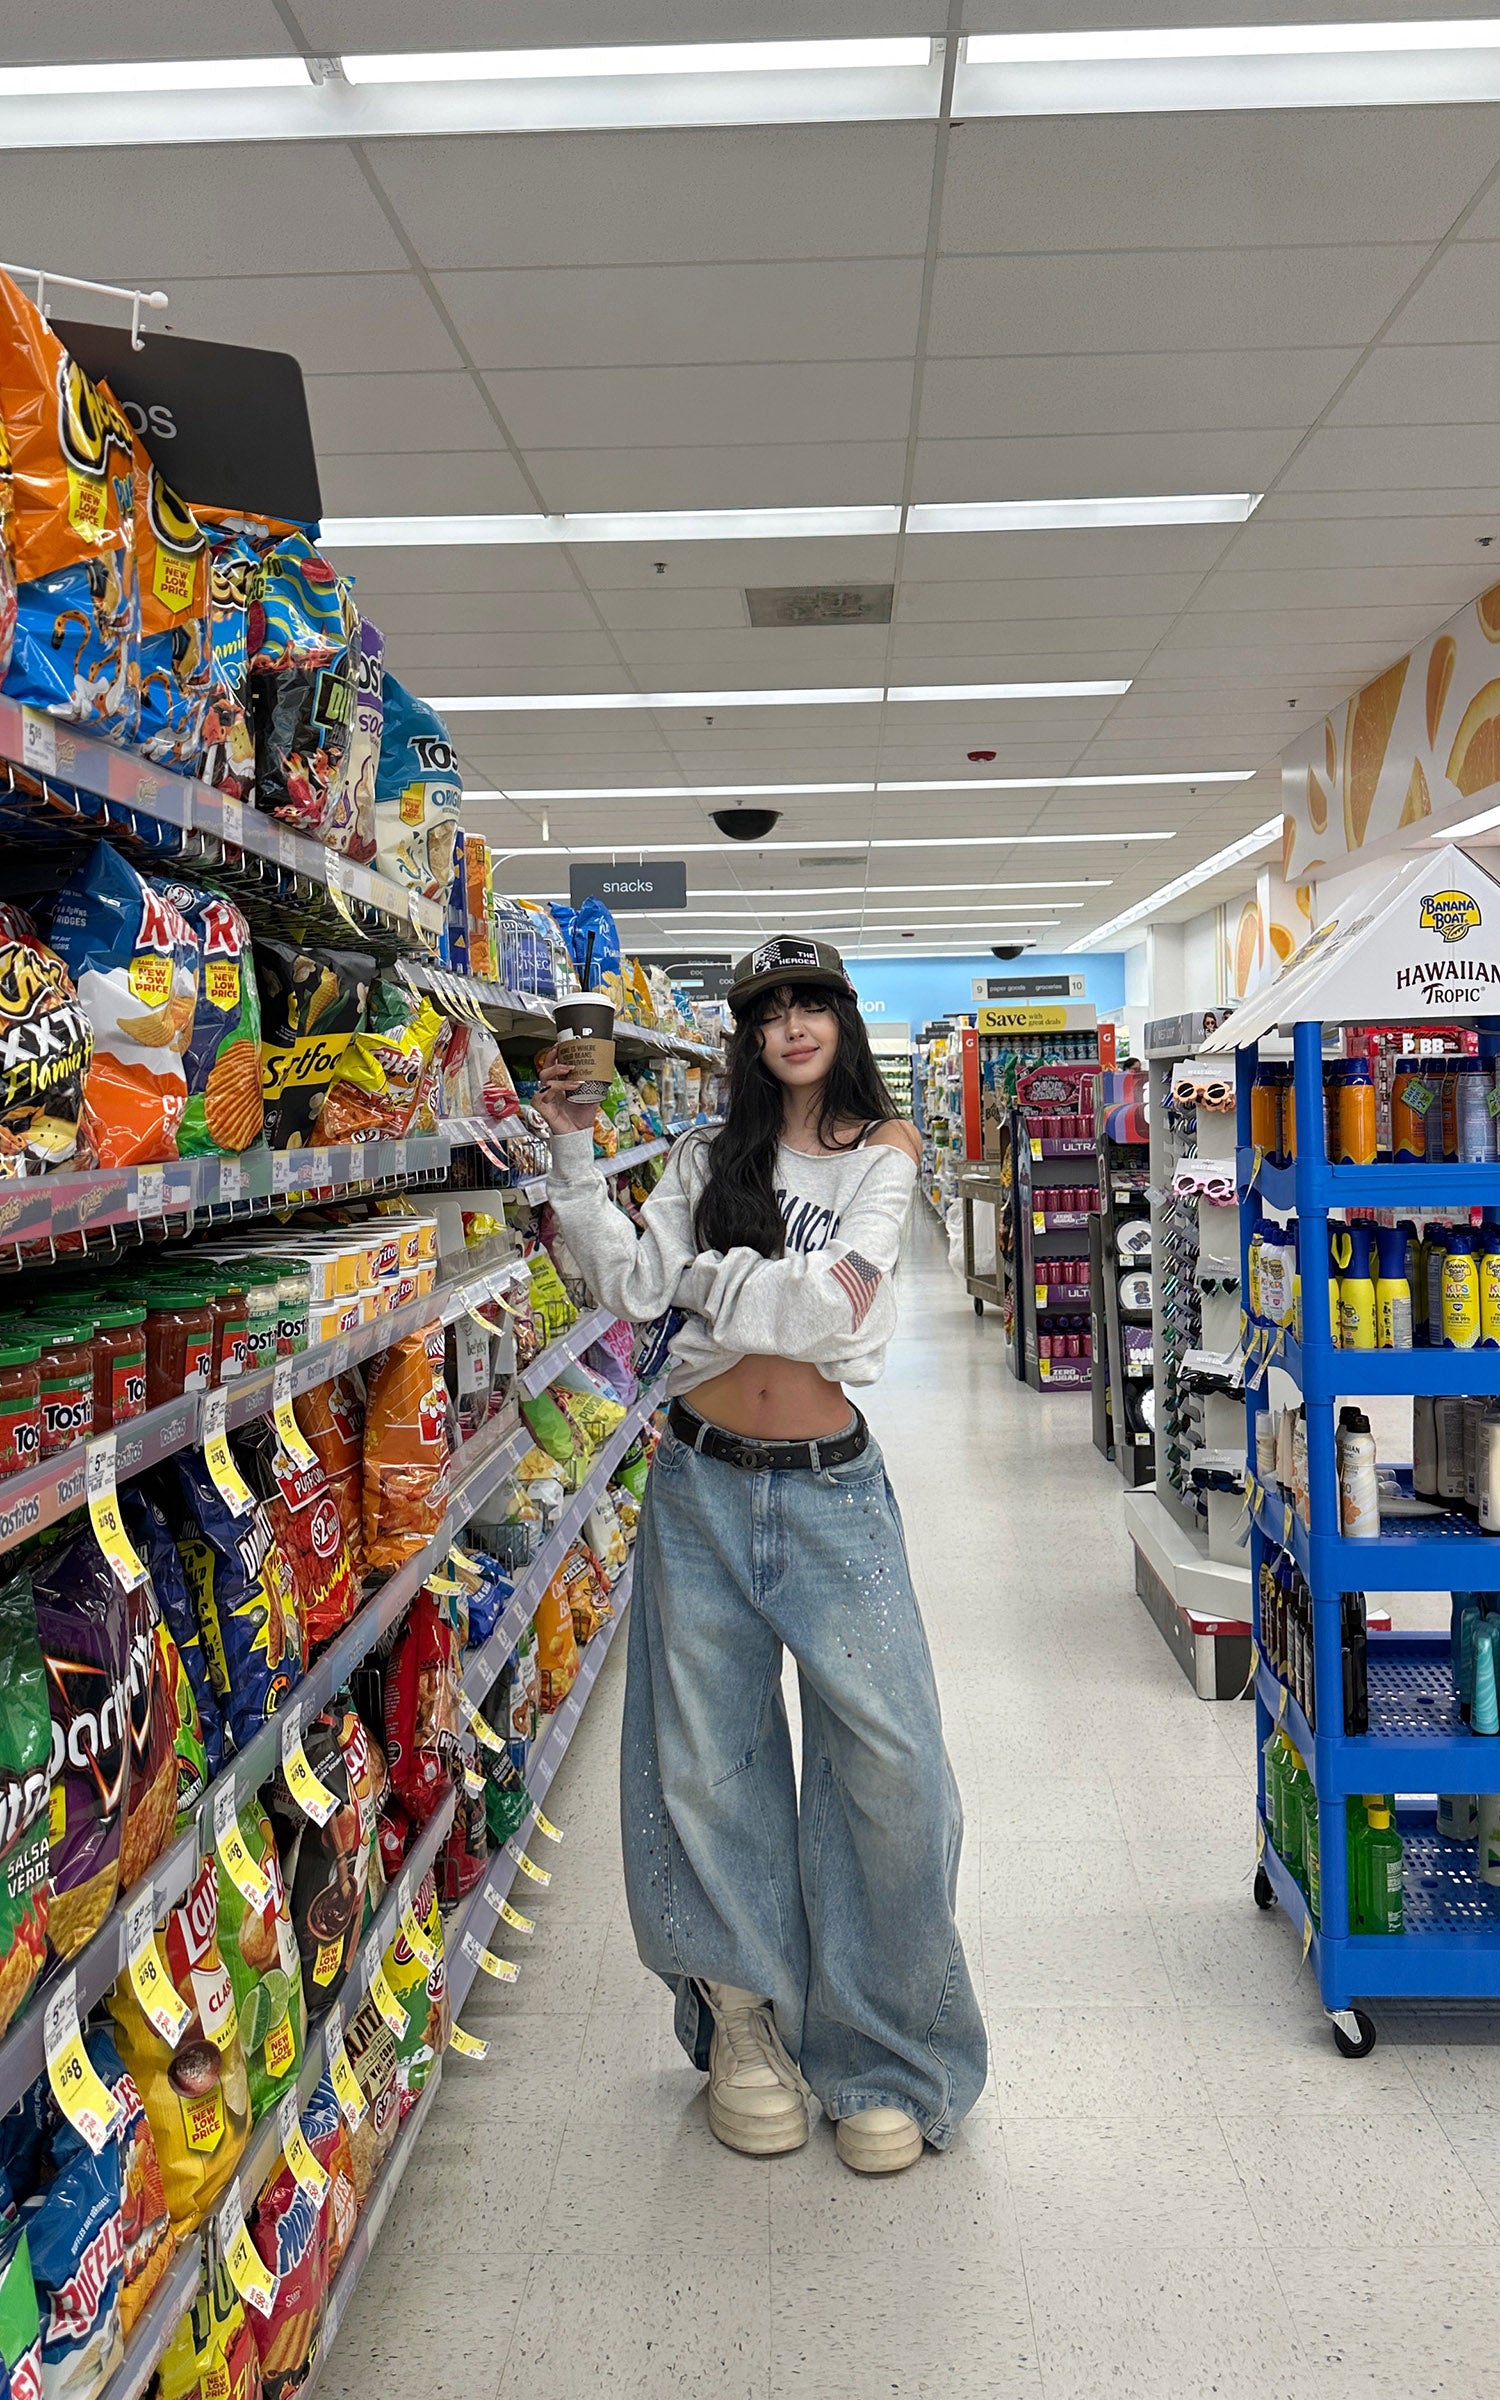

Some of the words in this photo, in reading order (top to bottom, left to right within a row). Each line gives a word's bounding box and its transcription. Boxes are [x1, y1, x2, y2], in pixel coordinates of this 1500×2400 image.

[80, 491, 100, 505] NEW
[79, 502, 97, 515] LOW
[166, 567, 188, 579] NEW
[165, 576, 187, 588] LOW
[160, 583, 188, 598] PRICE
[603, 879, 653, 893] snacks
[1423, 898, 1475, 915] BANANA
[1432, 912, 1467, 930] BOAT
[779, 957, 817, 966] HEROES
[797, 951, 815, 959] THE
[138, 967, 166, 979] NEW
[214, 973, 234, 983] NEW
[1396, 960, 1500, 990] HAWAIIAN
[135, 983, 169, 995] PRICE
[214, 981, 235, 990] LOW
[1072, 982, 1082, 990] 10
[210, 988, 238, 999] PRICE
[1421, 982, 1481, 1005] TROPIC
[986, 1012, 1027, 1027] Save
[1063, 1143, 1096, 1151] ULTRA
[1446, 1284, 1469, 1293] KIDS
[1051, 1374, 1080, 1382] SUGAR
[1052, 1368, 1076, 1376] ZERO
[99, 1511, 116, 1531] 2/$8
[7, 1838, 50, 1880] SALSA
[227, 1842, 243, 1863] 2/$8
[319, 1955, 337, 1967] LOW
[140, 1960, 157, 1985] 2/$8
[316, 1961, 340, 1976] PRICE
[271, 2033, 289, 2049] NEW
[272, 2043, 291, 2058] LOW
[270, 2049, 293, 2069] PRICE
[60, 2056, 83, 2088] 2/$8
[192, 2103, 215, 2123] NEW
[194, 2113, 216, 2132] LOW
[191, 2120, 221, 2143] PRICE
[234, 2243, 247, 2270] 2/$7
[206, 2373, 227, 2385] NEW
[207, 2380, 227, 2391] LOW
[205, 2387, 229, 2399] PRICE
